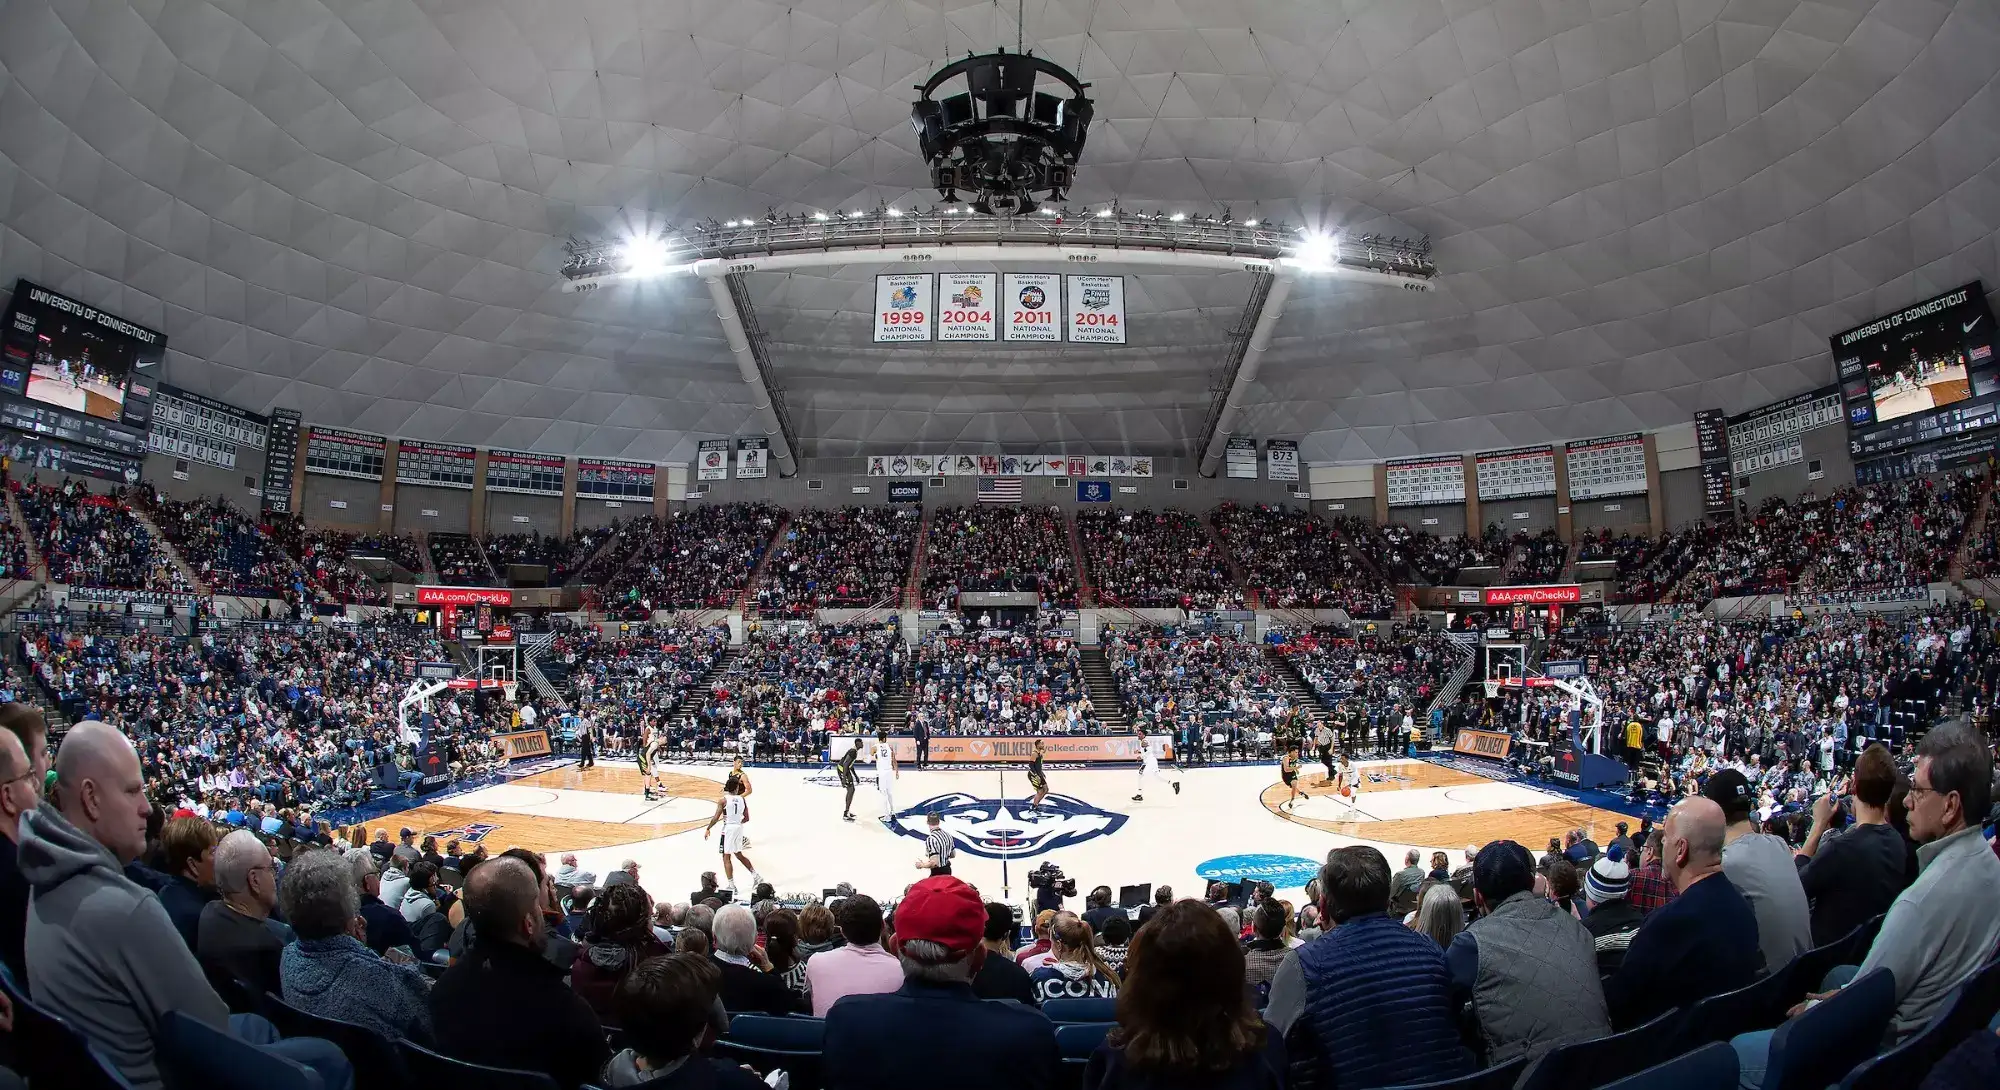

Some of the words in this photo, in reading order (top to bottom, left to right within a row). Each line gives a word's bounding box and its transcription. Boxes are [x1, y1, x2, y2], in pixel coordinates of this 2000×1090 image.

[16, 312, 36, 325] WELLS
[30, 289, 84, 316] UNIVERSITY
[84, 308, 97, 320] OF
[98, 313, 156, 344] CONNECTICUT
[882, 312, 924, 324] 1999
[943, 311, 991, 323] 2004
[1014, 311, 1051, 323] 2011
[1076, 313, 1118, 326] 2014
[1842, 320, 1890, 345] UNIVERSITY
[1892, 314, 1904, 326] OF
[1904, 291, 1968, 324] CONNECTICUT
[14, 321, 34, 333] FARGO
[1841, 356, 1860, 367] WELLS
[1842, 364, 1861, 375] FARGO
[1, 370, 20, 382] CBS
[154, 406, 166, 416] 52
[1851, 407, 1867, 417] CBS
[184, 414, 194, 424] 00
[200, 419, 208, 429] 13
[1787, 419, 1796, 430] 42
[1802, 416, 1809, 426] 25
[213, 423, 224, 433] 42
[1759, 428, 1767, 438] 21
[1773, 424, 1782, 434] 52
[335, 431, 382, 442] CHAMPIONSHIP
[1590, 435, 1638, 445] CHAMPIONSHIP
[1731, 436, 1741, 446] 24
[1744, 432, 1754, 442] 50
[424, 444, 472, 453] CHAMPIONSHIP
[513, 453, 561, 461] CHAMPIONSHIP
[1272, 451, 1292, 460] 873
[603, 461, 651, 469] CHAMPIONSHIP
[274, 502, 286, 511] 1:23
[424, 592, 508, 604] AAA.com/CheckUp
[1491, 590, 1575, 601] AAA.com/CheckUp
[424, 666, 451, 676] UCONN
[1552, 666, 1577, 674] UCONN
[512, 736, 544, 754] YOLKED
[907, 743, 964, 757] yoed.com
[991, 742, 1032, 758] YOLKED
[1474, 735, 1504, 754] YOLKED
[881, 749, 888, 757] 12
[423, 774, 448, 786] TRAVELERS
[1553, 770, 1579, 782] TRAVELERS
[735, 803, 738, 814] 1
